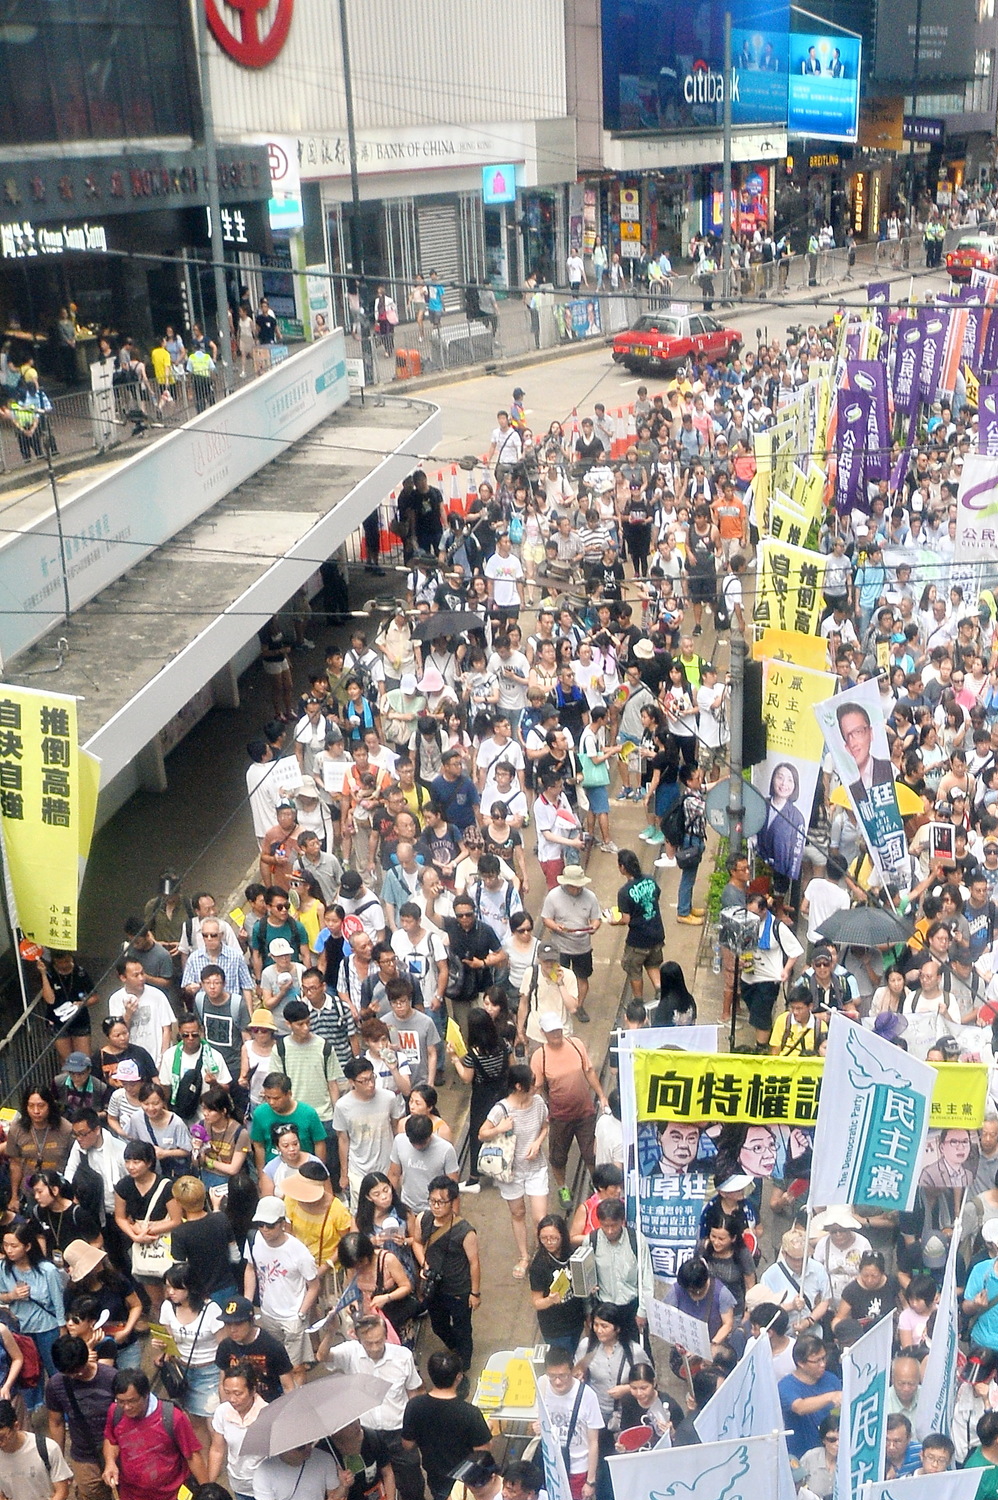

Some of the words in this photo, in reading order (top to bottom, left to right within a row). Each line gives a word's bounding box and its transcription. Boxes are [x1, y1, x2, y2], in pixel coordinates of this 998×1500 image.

[376, 142, 405, 160] BANK
[406, 143, 422, 158] OF
[422, 139, 456, 157] CHINA
[809, 153, 839, 169] BREITLING
[206, 206, 248, 243] 生生
[39, 706, 71, 828] 推倒高牆
[840, 1123, 862, 1172] Democratic
[851, 1092, 865, 1123] Party
[866, 1087, 917, 1200] 民主黨
